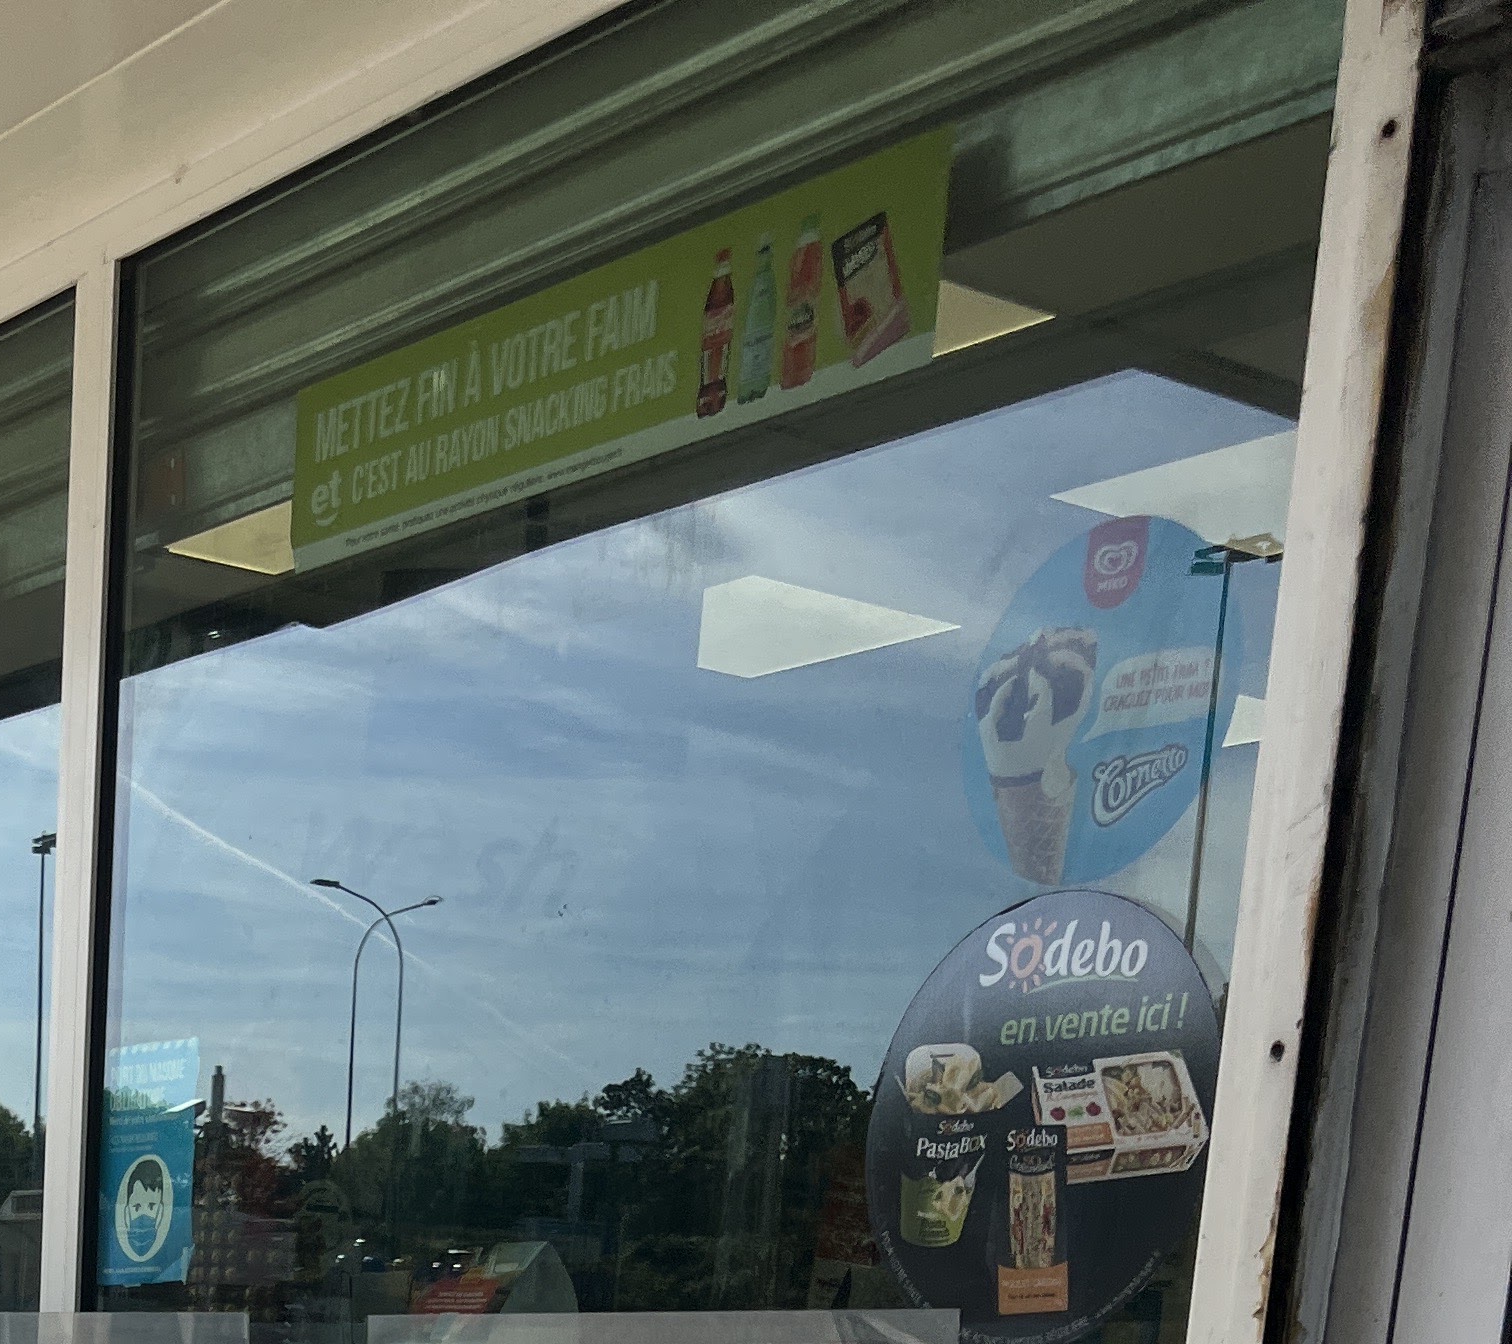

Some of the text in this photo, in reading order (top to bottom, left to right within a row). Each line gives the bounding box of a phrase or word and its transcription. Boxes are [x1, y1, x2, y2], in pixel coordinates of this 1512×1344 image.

[315, 280, 660, 463] METTEZ FIN À VOTRE FAIM
[352, 450, 402, 504] C'EST
[406, 441, 431, 486] AU
[433, 415, 500, 477] RAYON
[505, 375, 609, 451] SNACKING
[612, 350, 679, 413] FRAIS
[1097, 576, 1129, 593] MIKO
[1092, 745, 1187, 826] Cornetto
[979, 919, 1148, 988] Sodebo
[1000, 1016, 1036, 1046] en
[1045, 1004, 1130, 1042] vente
[1137, 993, 1173, 1033] ici
[1043, 1078, 1096, 1095] Salade
[1006, 1129, 1058, 1152] Sodebo
